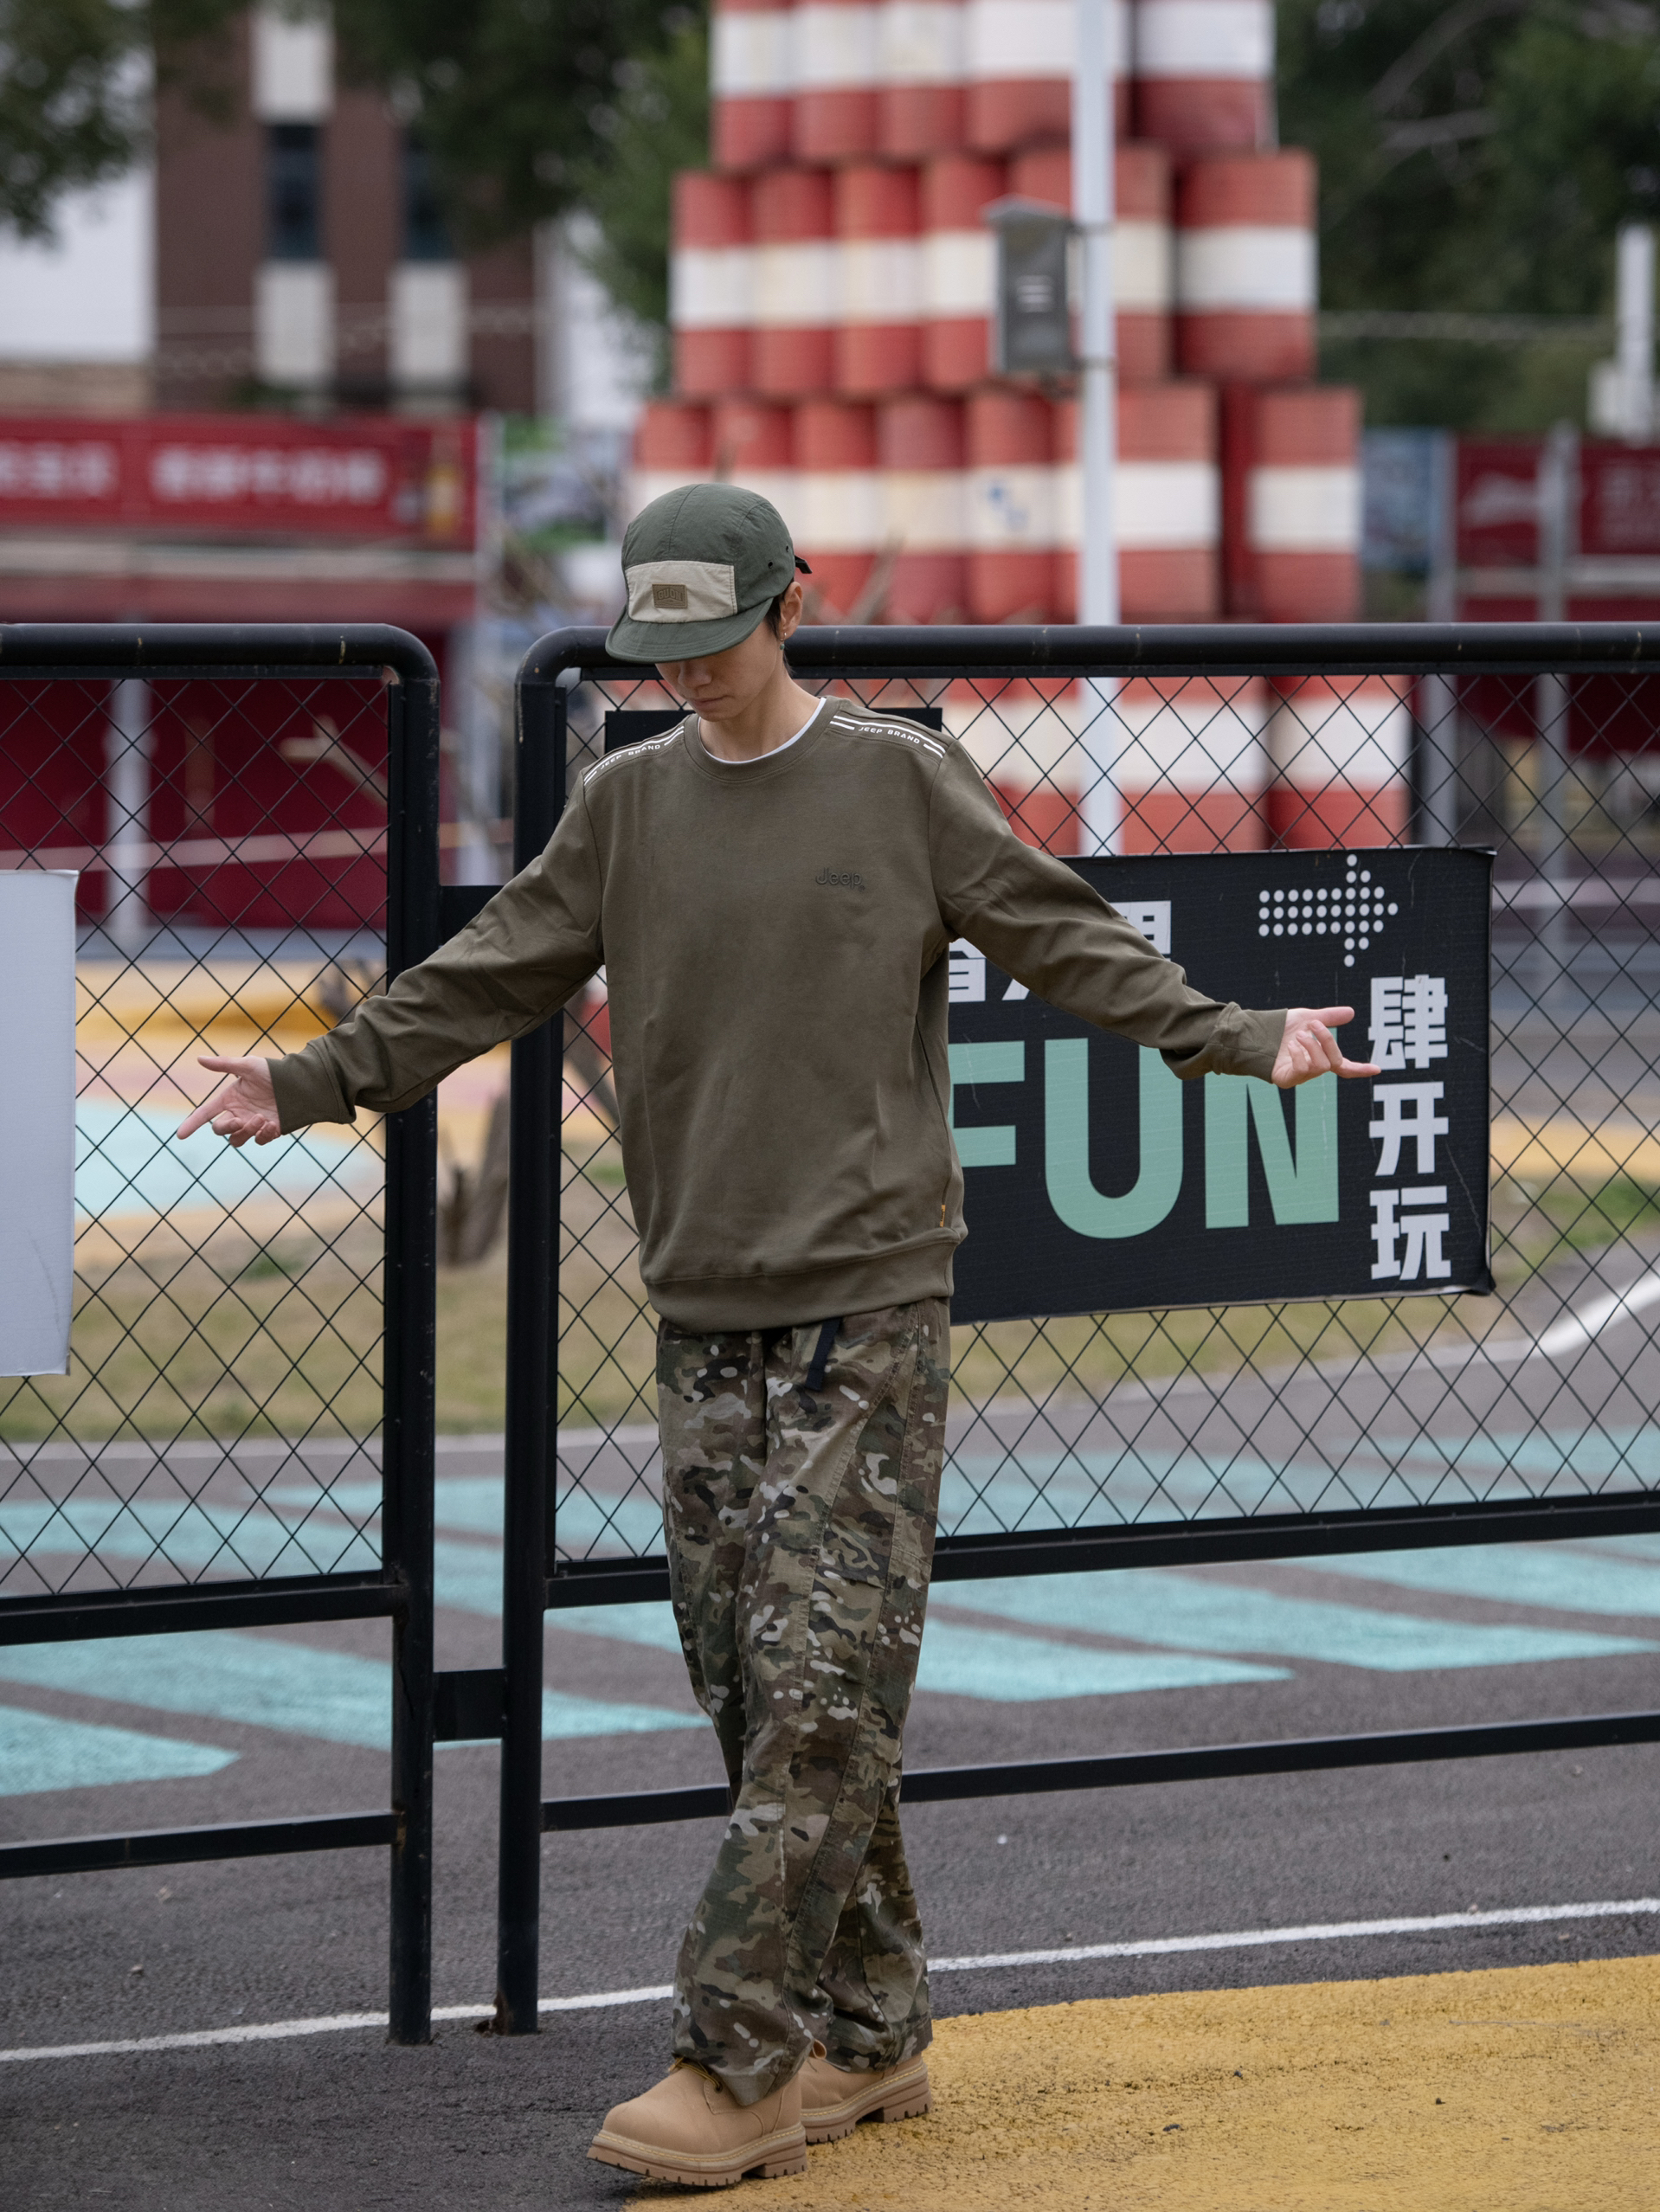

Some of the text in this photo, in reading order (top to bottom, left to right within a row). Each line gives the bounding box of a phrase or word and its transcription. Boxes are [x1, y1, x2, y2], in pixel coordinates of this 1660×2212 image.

[887, 730, 920, 744] BRAND
[601, 744, 660, 769] JEEP BRAND
[815, 867, 862, 890] Jeep
[1368, 974, 1451, 1281] 肆开玩
